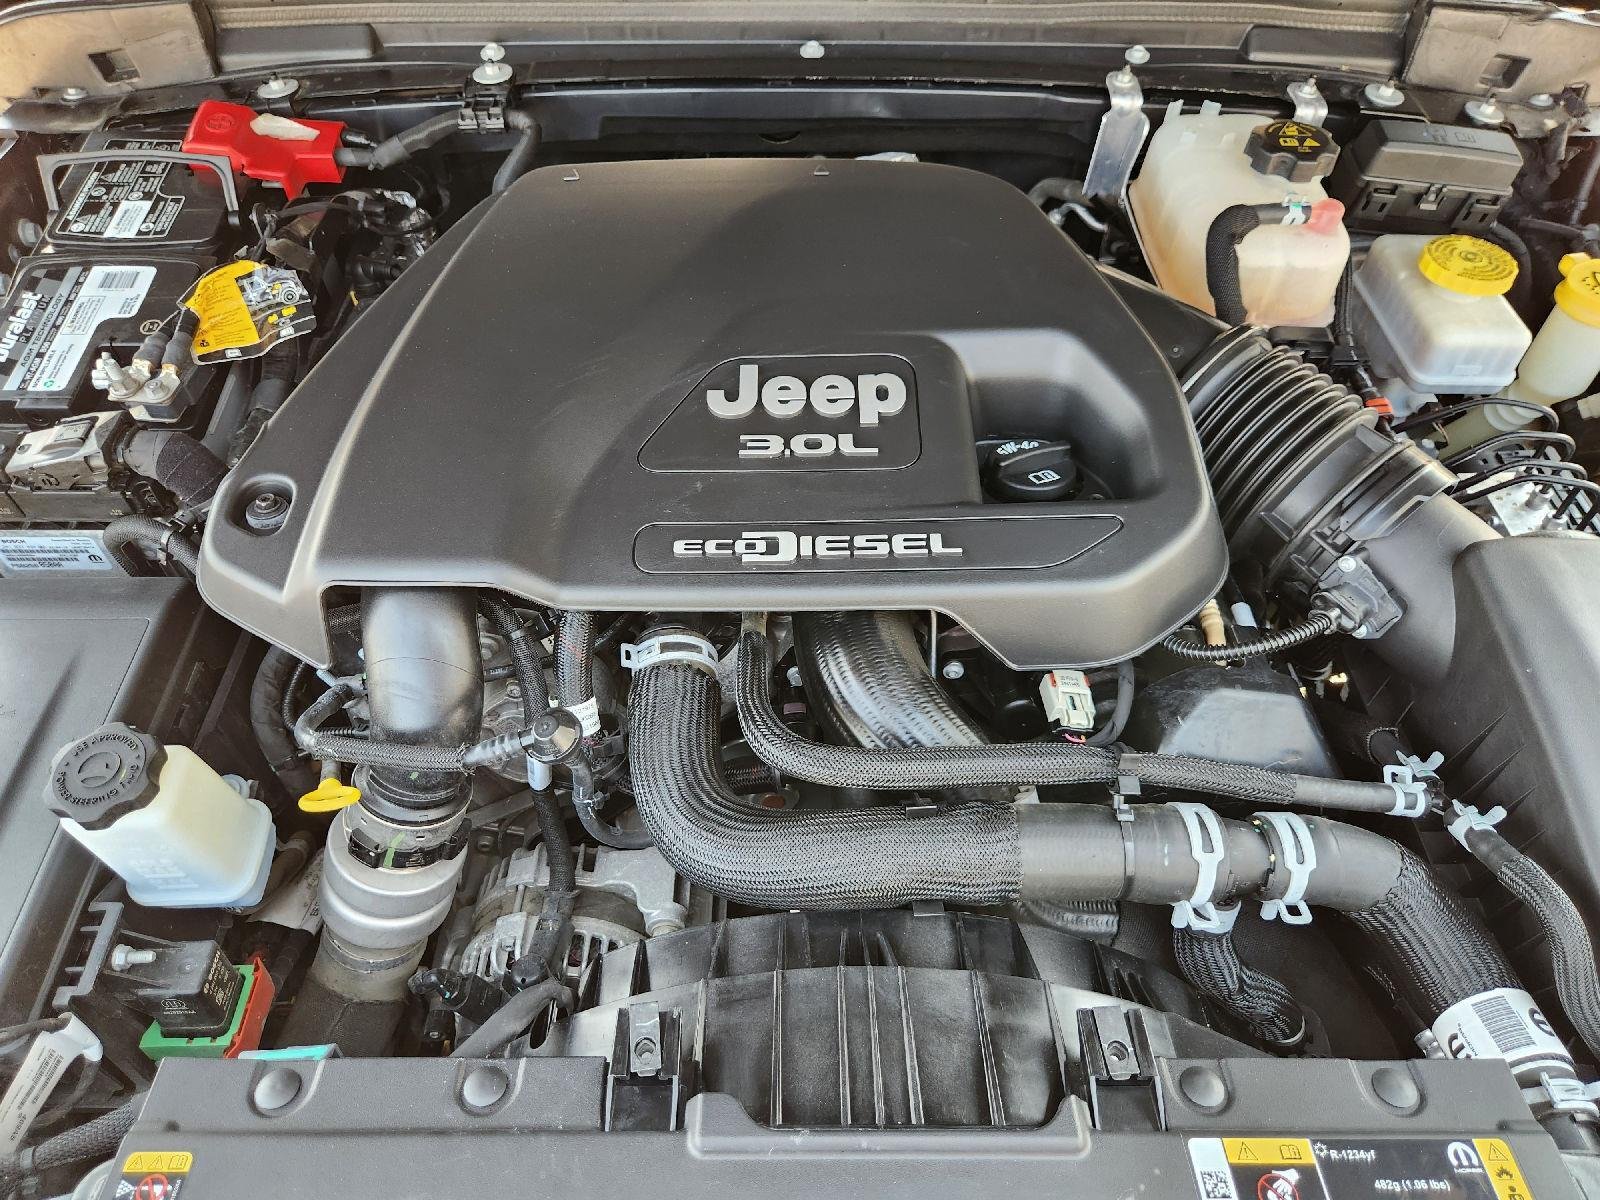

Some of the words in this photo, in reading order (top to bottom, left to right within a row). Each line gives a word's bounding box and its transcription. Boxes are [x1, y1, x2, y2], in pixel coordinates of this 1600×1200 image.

[19, 294, 53, 344] PLATINUM
[21, 347, 34, 367] AGM
[33, 293, 65, 345] TECHNOLOGY
[706, 364, 907, 427] Jeep
[739, 433, 879, 459] 3.0L
[91, 733, 138, 751] APPROVED
[208, 950, 221, 980] BOSCH
[1329, 1149, 1376, 1162] R-1234yf
[1374, 1179, 1401, 1192] 482g
[1402, 1179, 1428, 1192] (1.06
[1430, 1179, 1450, 1192] lbs)
